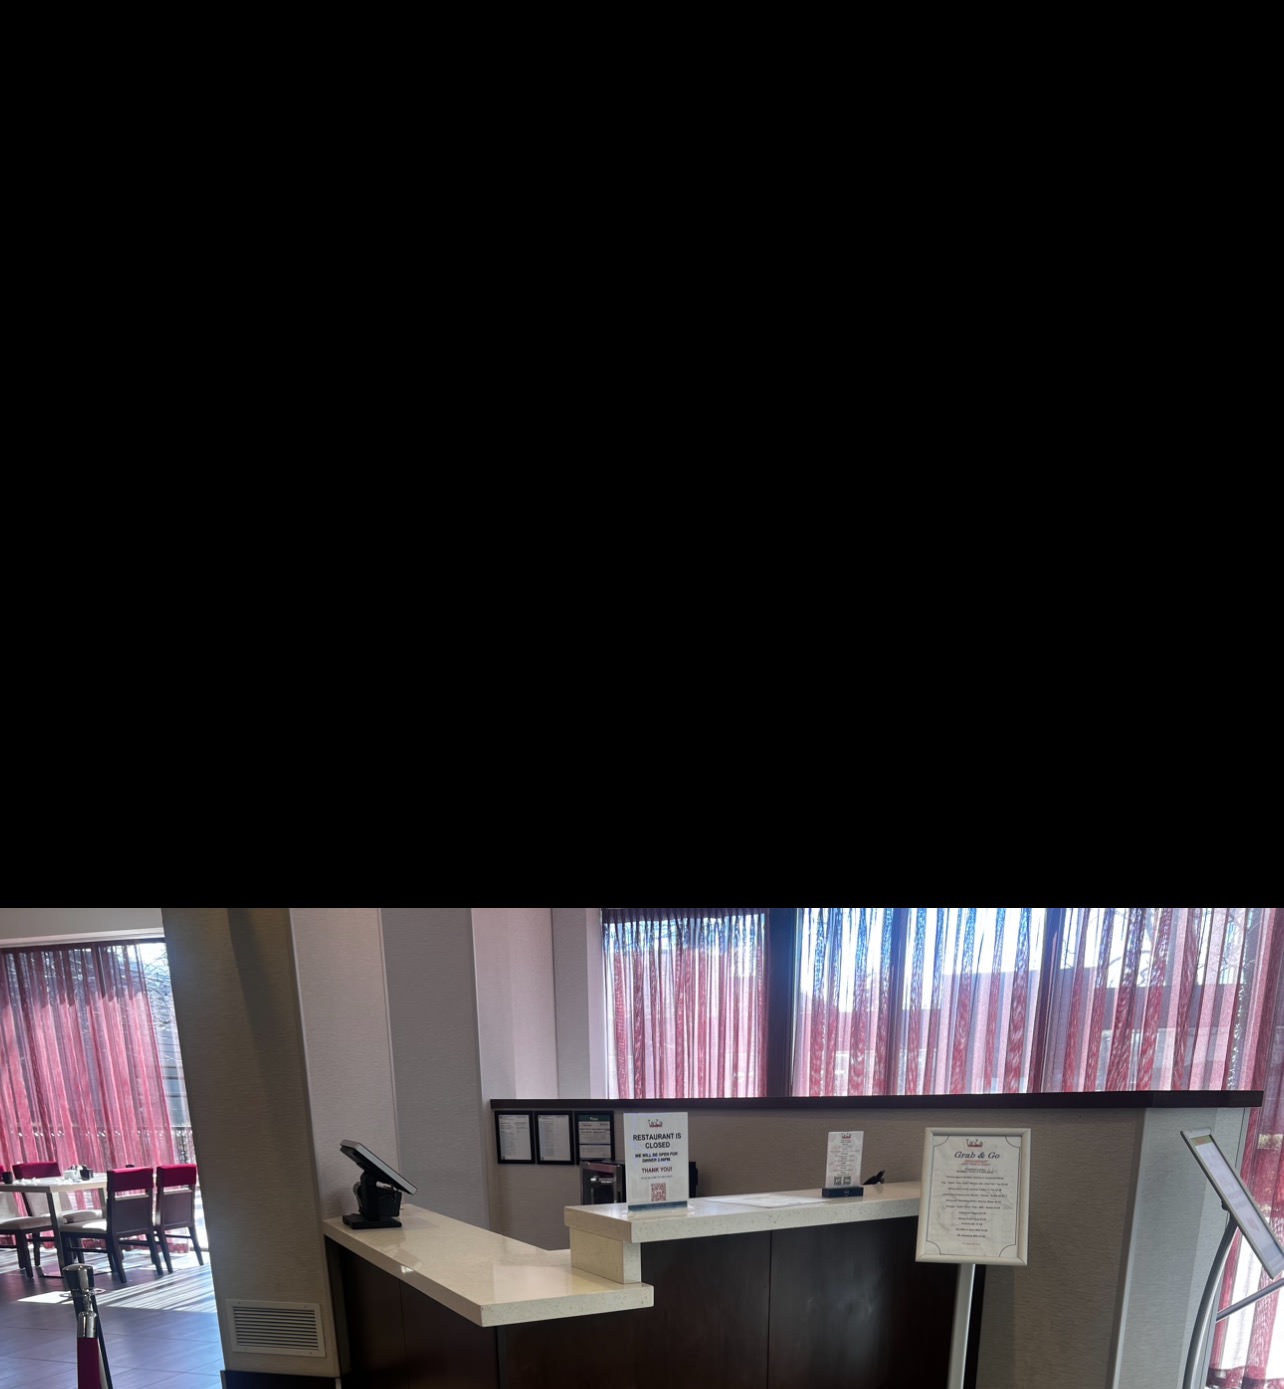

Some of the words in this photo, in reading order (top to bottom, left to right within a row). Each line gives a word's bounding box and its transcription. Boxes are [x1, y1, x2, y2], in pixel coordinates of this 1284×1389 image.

[633, 1133, 674, 1141] RESTAURANT
[954, 1151, 976, 1159] Grab
[988, 1152, 1000, 1160] Go
